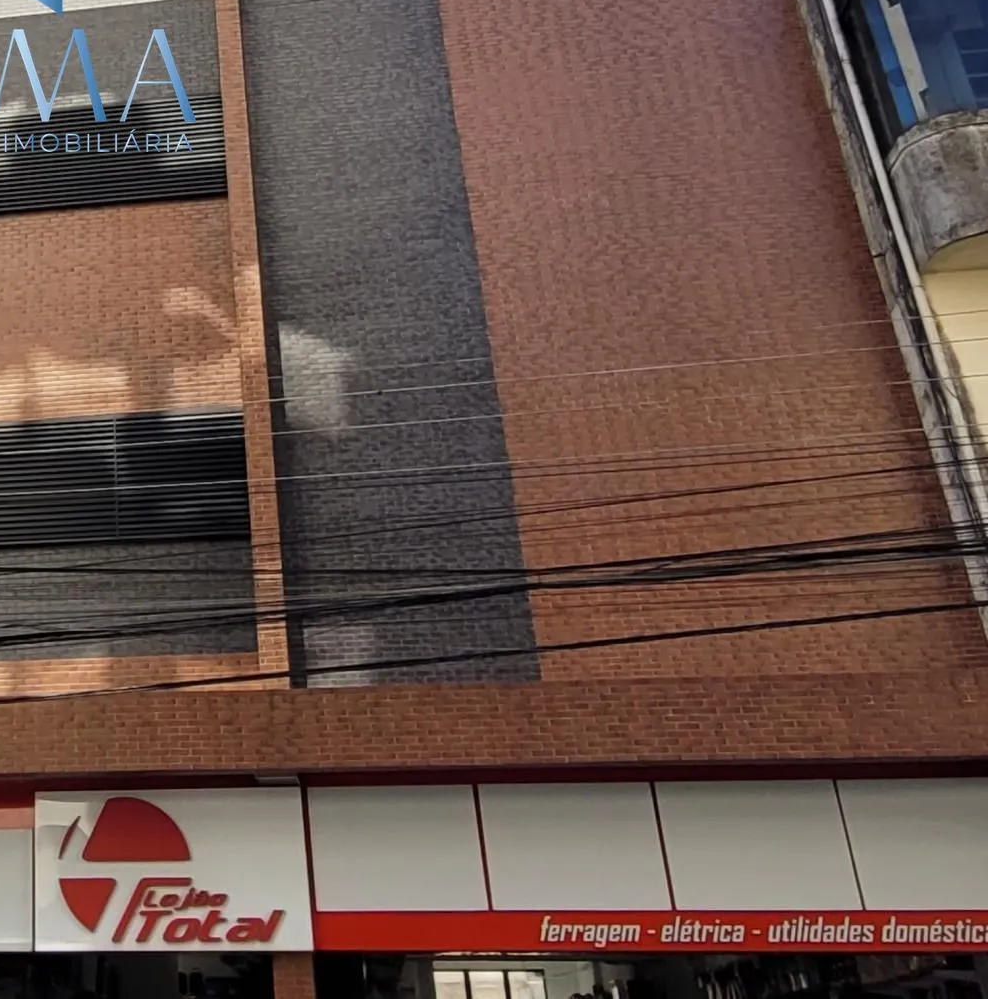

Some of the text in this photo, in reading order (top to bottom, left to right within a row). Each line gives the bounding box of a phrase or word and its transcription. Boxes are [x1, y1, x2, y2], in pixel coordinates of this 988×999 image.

[136, 910, 285, 944] Total
[540, 916, 640, 947] ferragem
[661, 917, 744, 942] elétrica
[768, 917, 874, 942] utilidades
